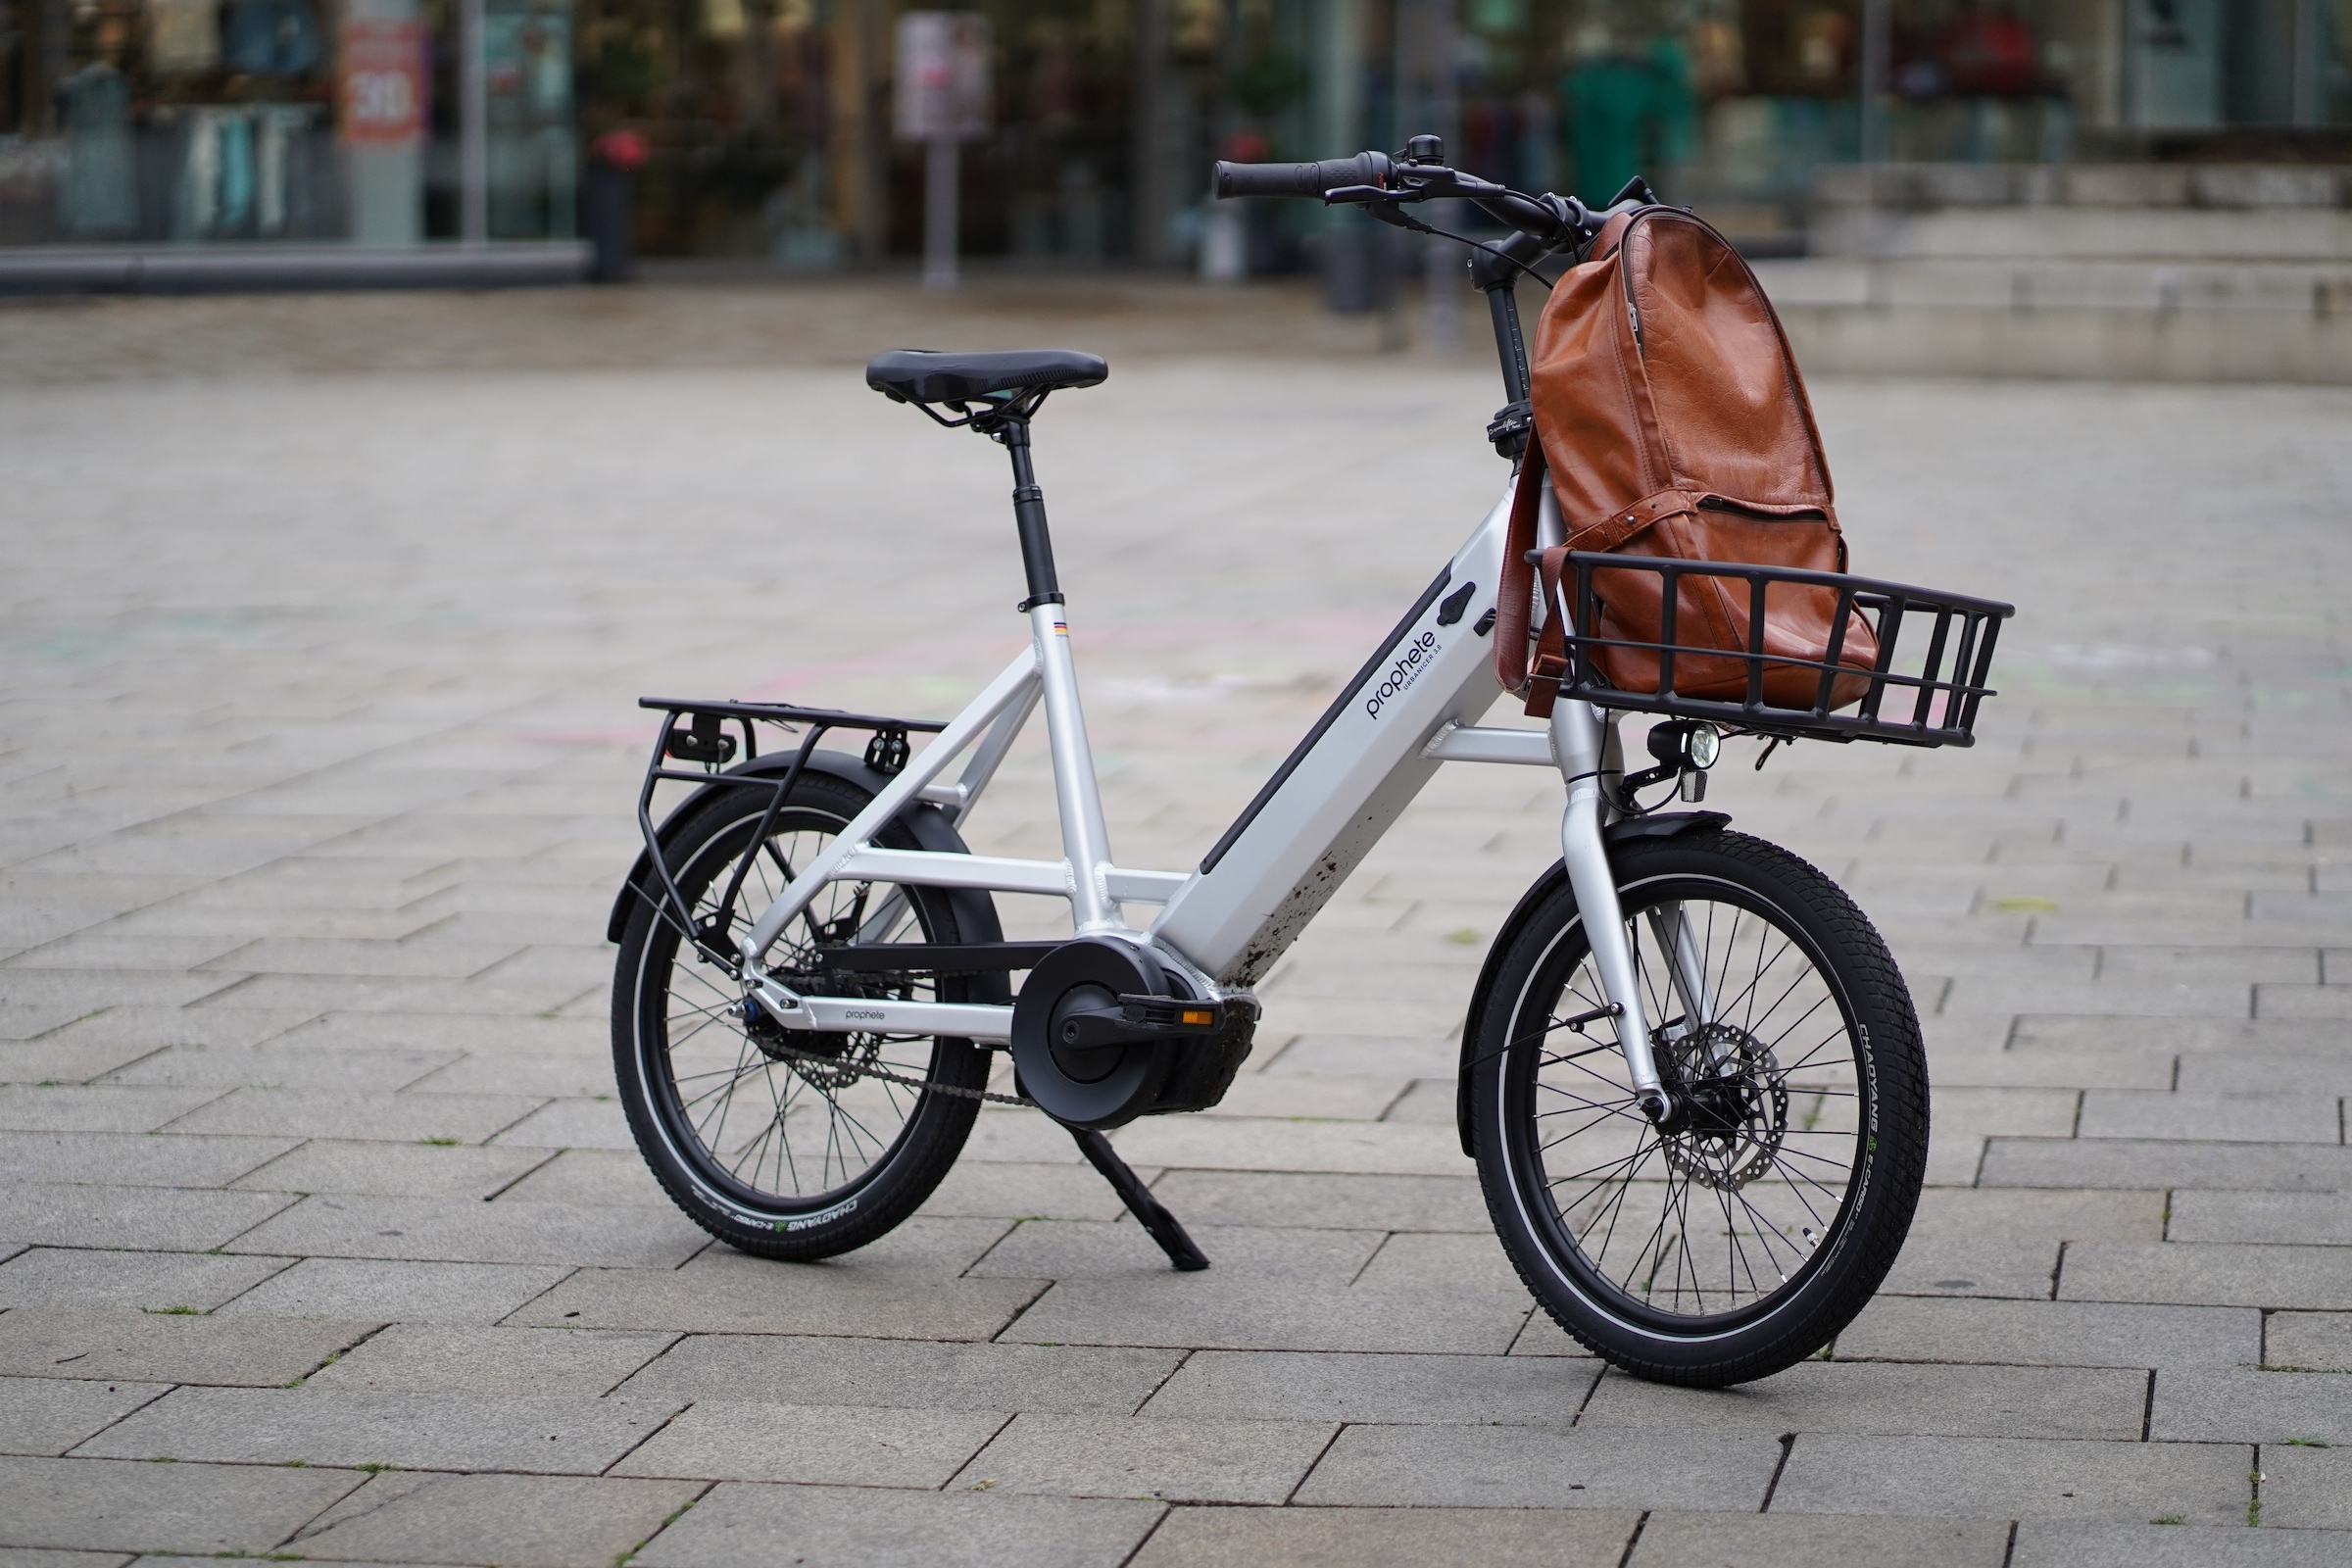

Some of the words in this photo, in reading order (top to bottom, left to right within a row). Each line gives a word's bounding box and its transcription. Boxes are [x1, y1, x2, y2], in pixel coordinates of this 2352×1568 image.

[1366, 631, 1436, 720] prophete
[1402, 655, 1434, 691] URBANICER
[846, 1010, 885, 1020] prophete
[1859, 1023, 1879, 1133] CHAOYANG
[786, 1200, 858, 1232] CHAOYANG
